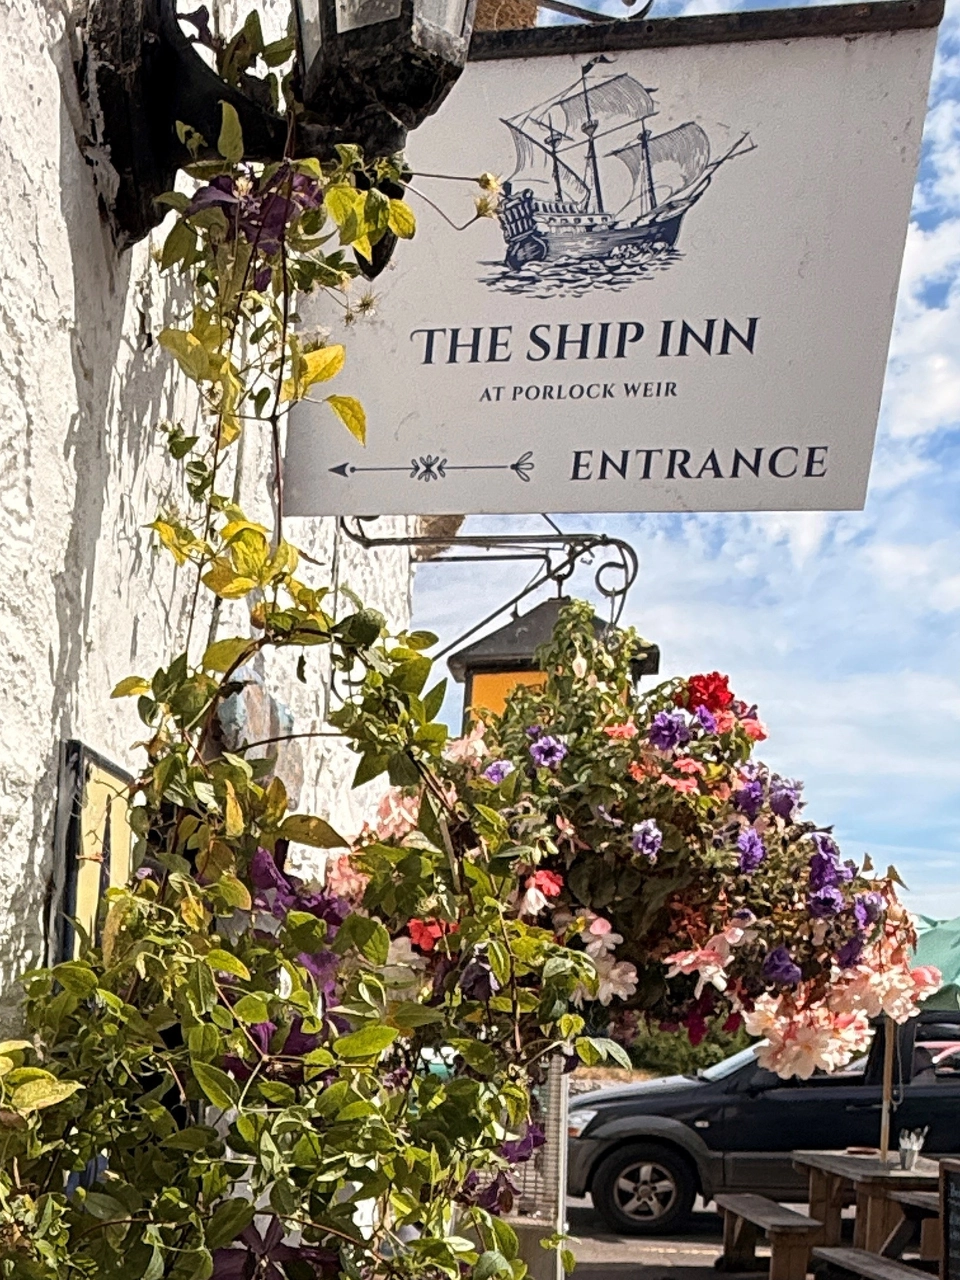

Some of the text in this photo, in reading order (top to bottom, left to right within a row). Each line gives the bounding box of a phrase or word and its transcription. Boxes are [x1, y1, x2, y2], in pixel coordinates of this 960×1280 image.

[410, 317, 760, 365] THE SHIP INN
[480, 381, 677, 402] AT PORLOCK WEIR
[570, 446, 829, 481] ENTRANCE
